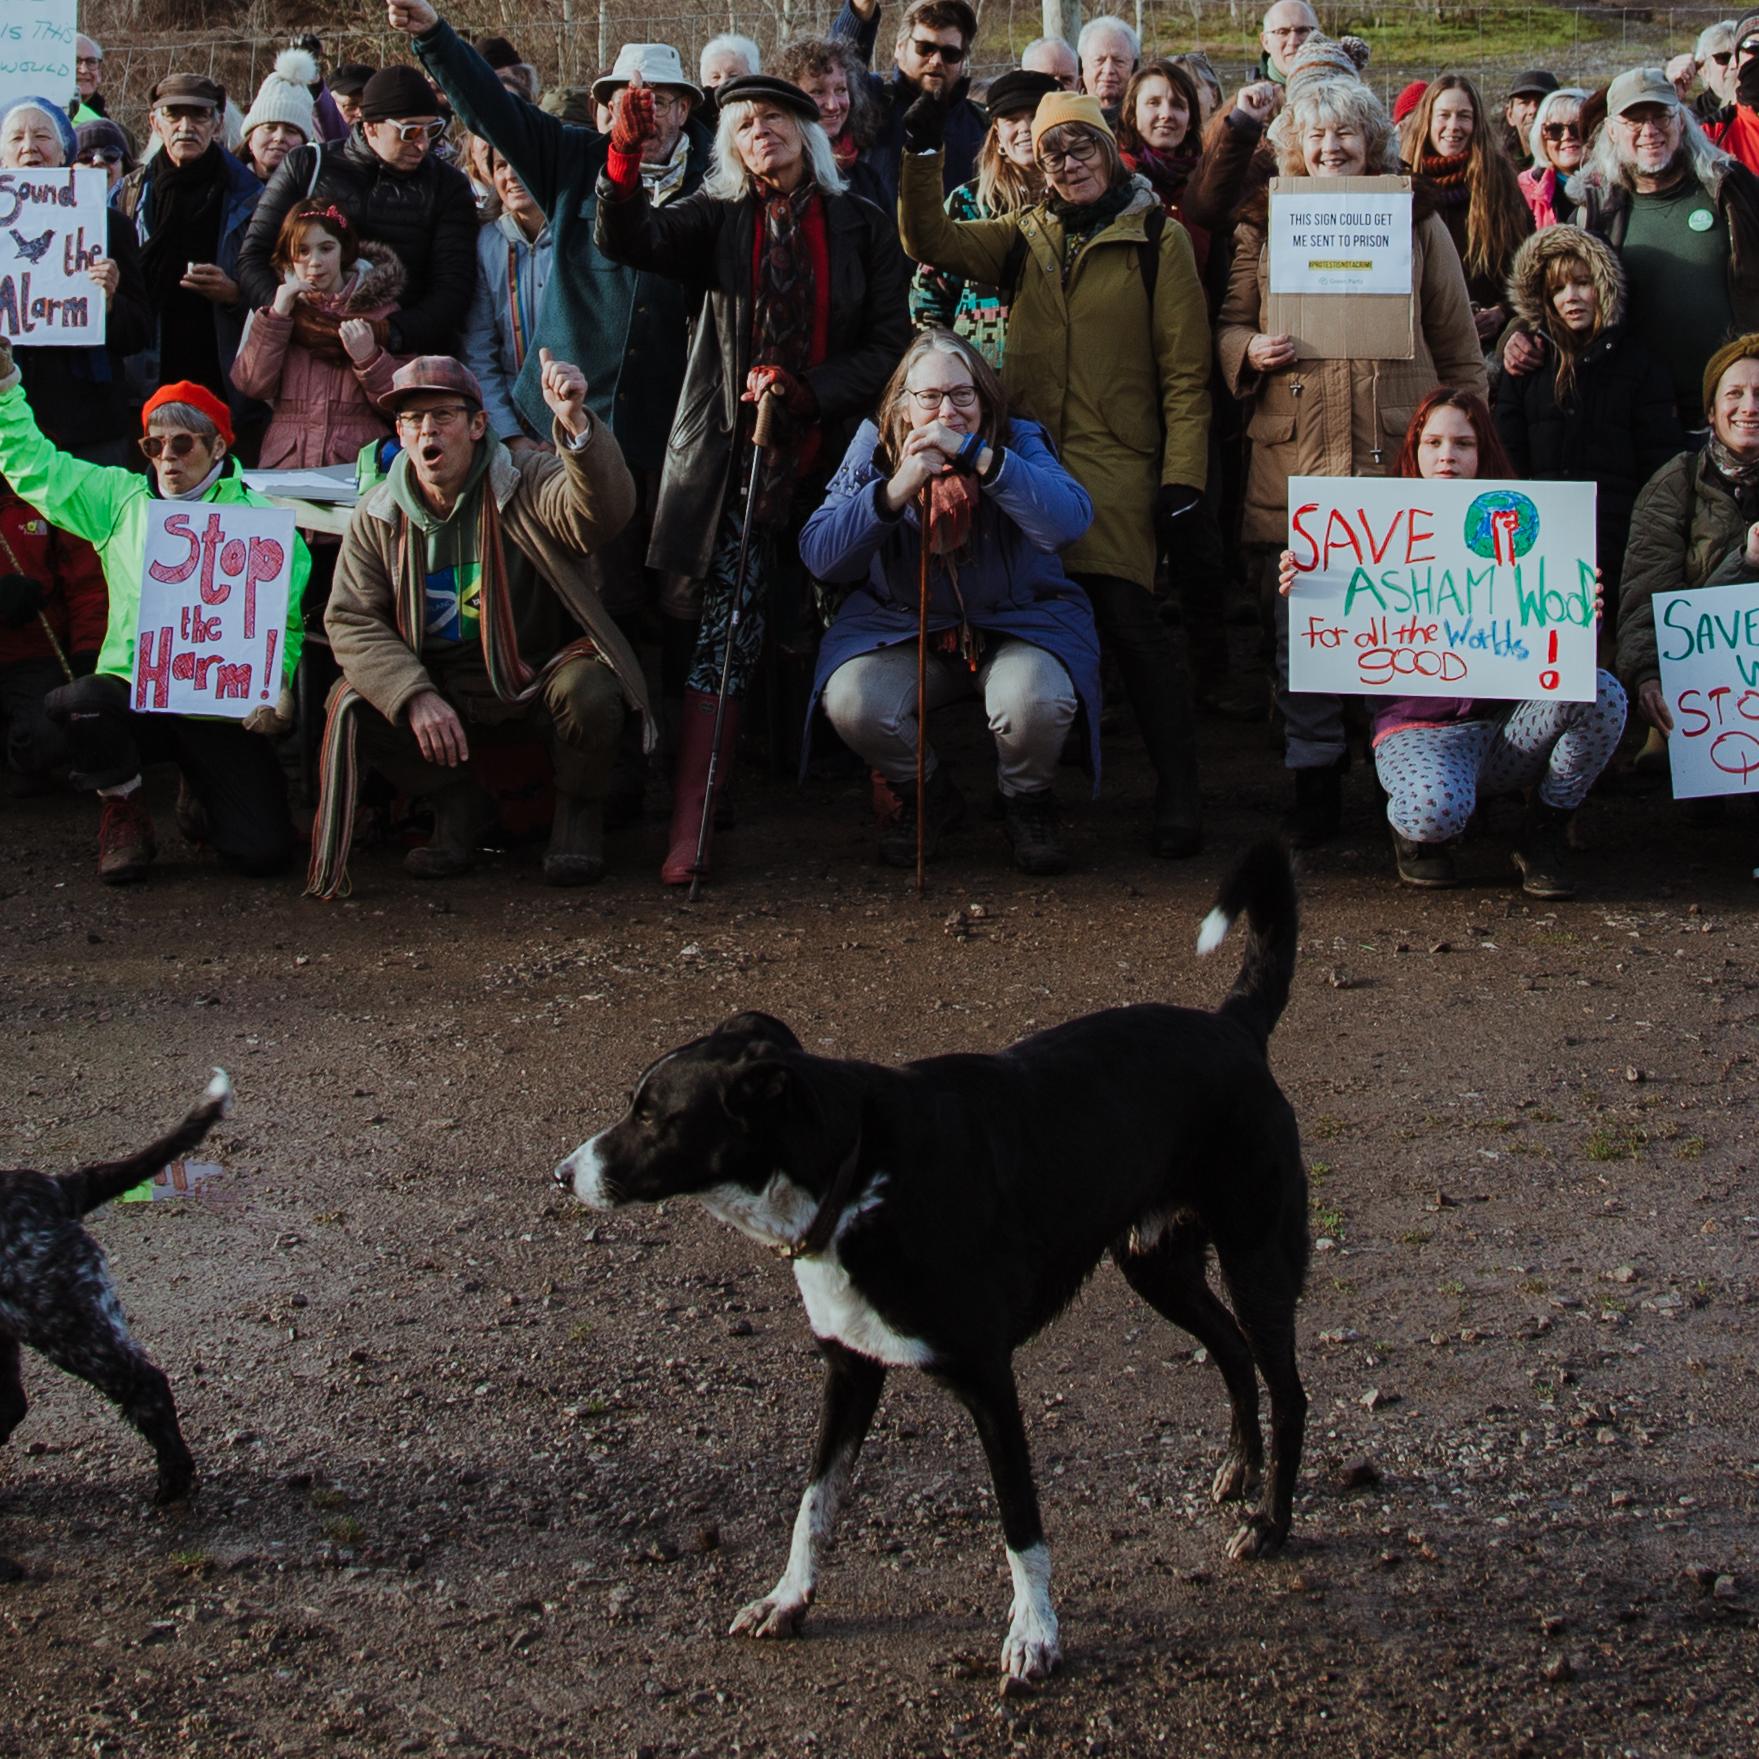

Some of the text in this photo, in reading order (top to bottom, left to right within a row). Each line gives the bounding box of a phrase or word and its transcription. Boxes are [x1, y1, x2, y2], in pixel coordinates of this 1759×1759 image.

[0, 23, 22, 39] IS
[32, 20, 76, 44] THIS
[0, 61, 69, 77] WOULD
[1290, 213, 1393, 226] THIS SIGN COULD GET
[63, 226, 102, 277] the
[1292, 235, 1389, 247] ME SENT TO PRISON
[1292, 503, 1436, 572] SAVE
[149, 513, 284, 639] Stop
[1344, 565, 1496, 617] ASHAM
[181, 605, 222, 643] the
[1354, 616, 1388, 648] all
[1392, 615, 1438, 645] the
